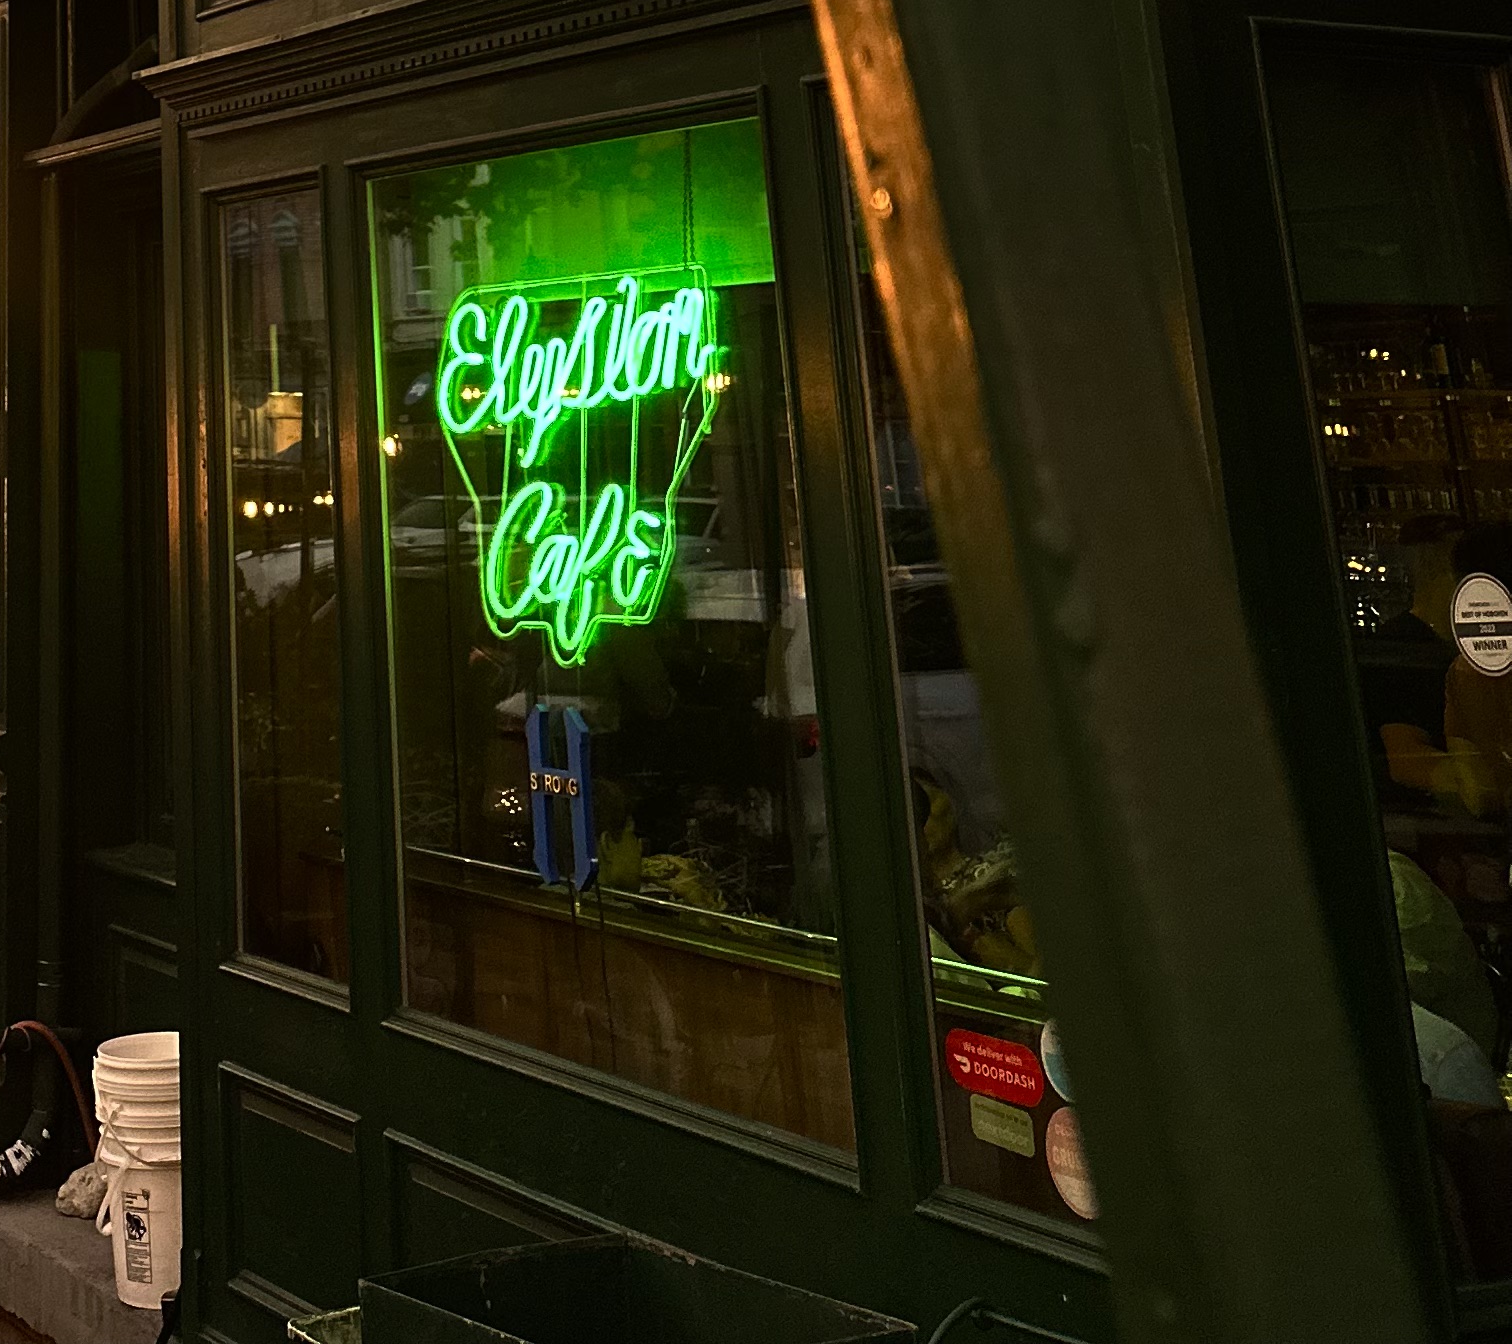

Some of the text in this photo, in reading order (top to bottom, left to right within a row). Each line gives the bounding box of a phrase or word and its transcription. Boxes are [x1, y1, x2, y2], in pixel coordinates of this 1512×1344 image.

[1472, 639, 1508, 651] WINNER
[530, 772, 578, 796] SROG
[974, 1062, 1035, 1089] DOORDASH
